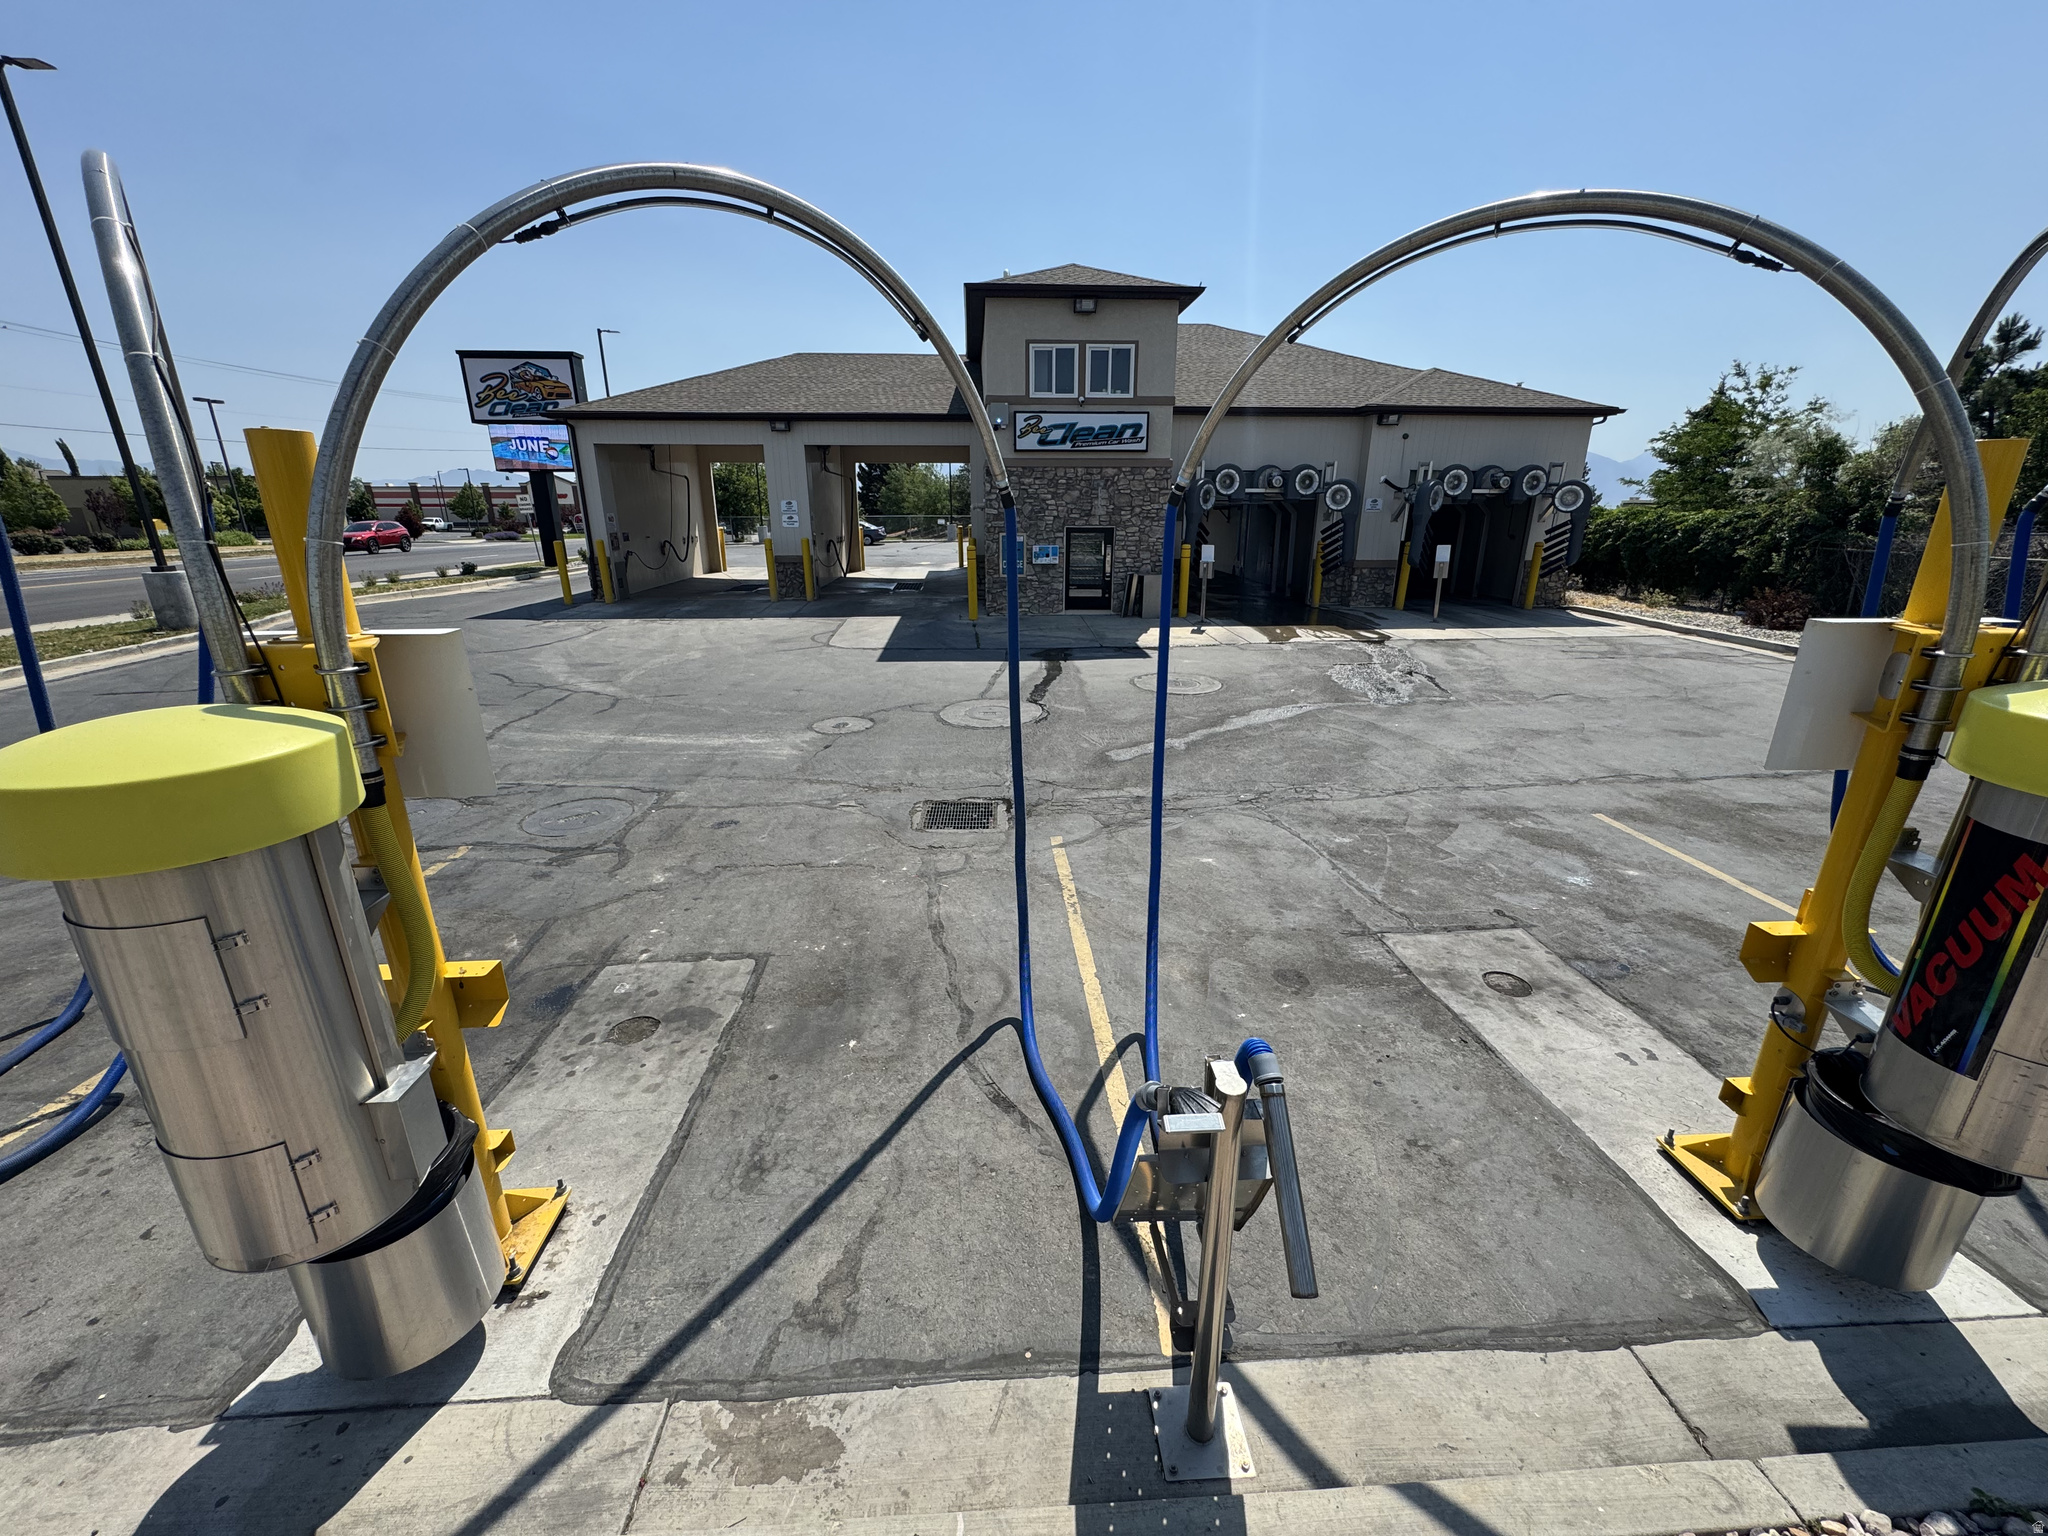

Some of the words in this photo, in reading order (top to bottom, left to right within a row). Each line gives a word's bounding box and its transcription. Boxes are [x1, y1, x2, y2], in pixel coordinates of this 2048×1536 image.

[475, 372, 527, 408] Bee
[488, 401, 559, 416] Clean
[1018, 415, 1053, 439] Bee
[1037, 421, 1143, 447] Clean
[1075, 439, 1106, 447] Premium
[1122, 436, 1142, 444] Wash
[509, 438, 550, 453] JUNE
[1892, 853, 2048, 1038] VACUUM
